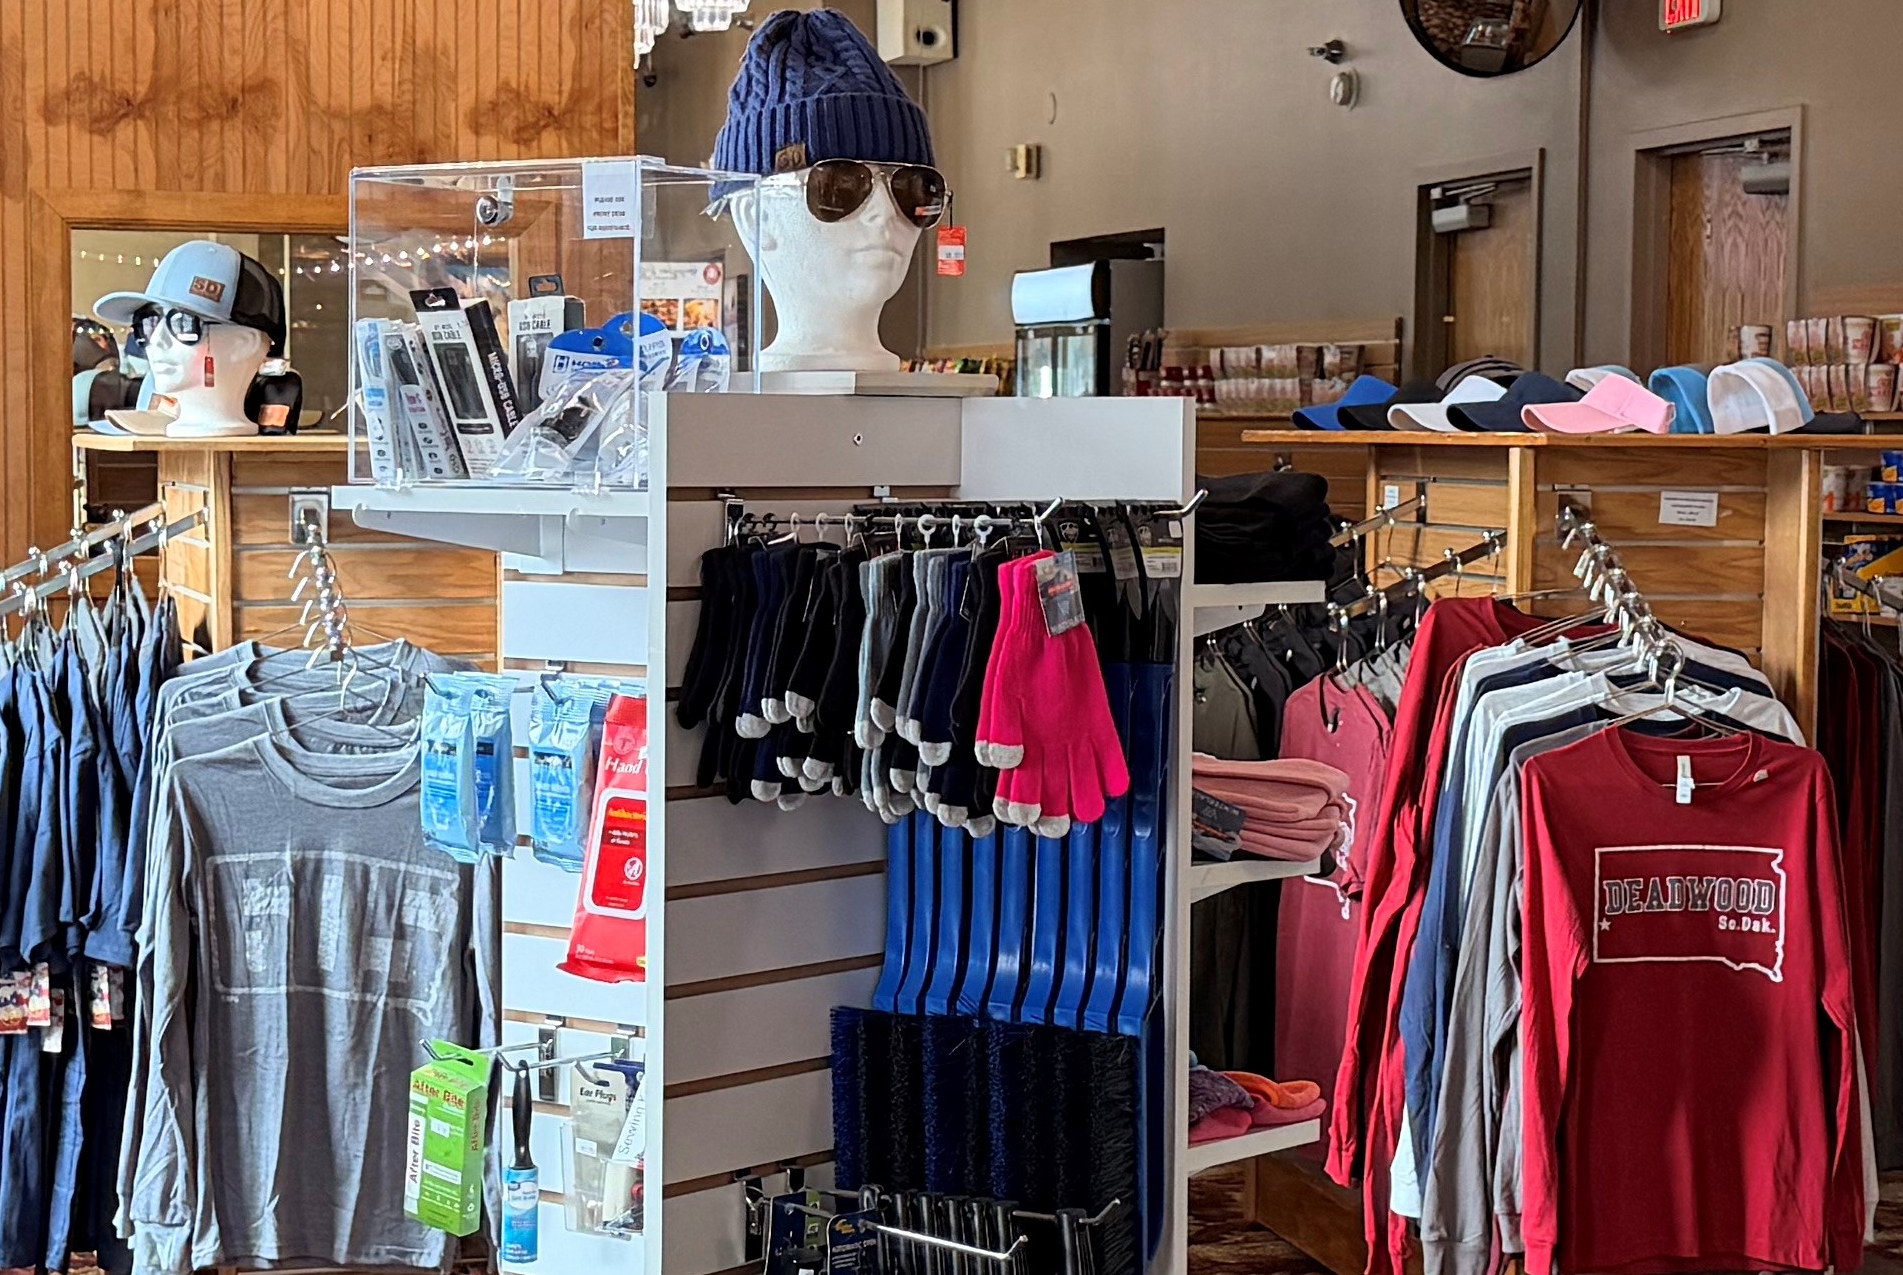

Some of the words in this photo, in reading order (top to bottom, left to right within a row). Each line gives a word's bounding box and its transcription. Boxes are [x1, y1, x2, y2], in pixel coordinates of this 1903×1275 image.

[604, 755, 643, 776] Hand
[1602, 877, 1776, 916] DEADWOOD
[413, 1079, 440, 1098] After
[442, 1089, 466, 1109] Bite
[579, 1087, 594, 1098] Ear
[595, 1089, 617, 1104] Plugs
[409, 1119, 421, 1148] Bite
[408, 1150, 419, 1184] After
